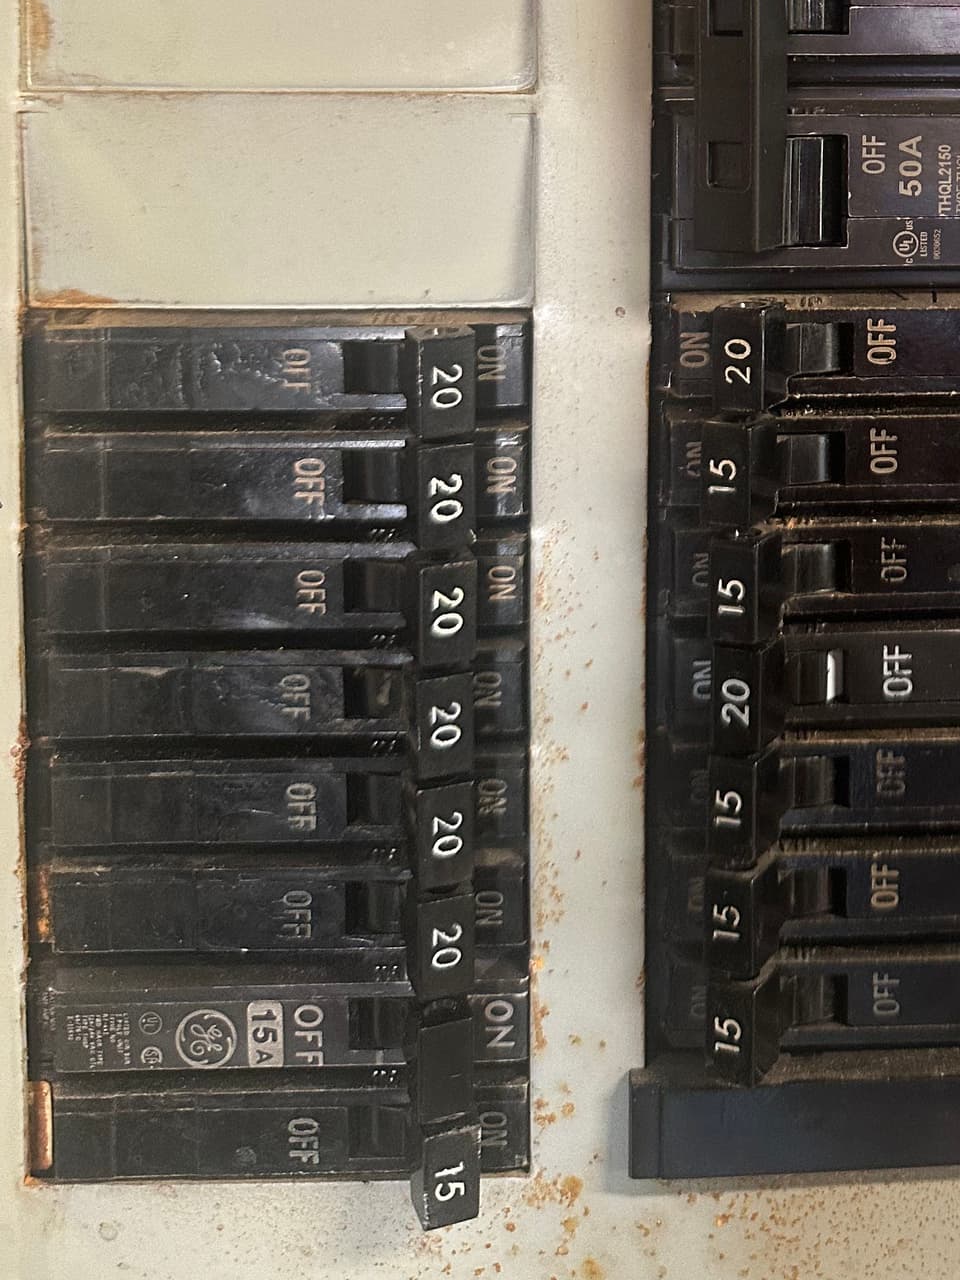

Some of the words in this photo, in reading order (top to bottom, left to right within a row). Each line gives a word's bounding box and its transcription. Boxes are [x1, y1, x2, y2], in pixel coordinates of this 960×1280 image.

[861, 134, 886, 175] OFF
[898, 135, 922, 196] 50A
[938, 144, 952, 213] THQL2150
[906, 220, 913, 230] US
[477, 346, 507, 383] ON
[680, 331, 712, 368] ON
[724, 338, 753, 385] 20
[867, 318, 898, 365] OFF
[282, 347, 311, 394] OFF
[431, 363, 463, 409] 20
[870, 427, 898, 475] OFF
[295, 457, 326, 506] OFF
[430, 473, 464, 523] 20
[486, 455, 518, 495] ON
[709, 457, 738, 496] 15
[881, 536, 908, 582] OFF
[296, 569, 326, 617] OFF
[488, 565, 515, 602] ON
[718, 578, 744, 616] 15
[431, 586, 464, 638] 20
[473, 671, 502, 710] ON
[882, 644, 913, 698] OFF
[281, 673, 310, 720] OFF
[721, 679, 751, 727] 20
[431, 700, 462, 750] 20
[875, 748, 906, 798] OFF
[286, 781, 316, 832] OFF
[478, 779, 508, 815] ON
[715, 789, 742, 827] 15
[431, 810, 464, 859] 20
[475, 889, 504, 927] ON
[871, 863, 899, 910] OFF
[282, 889, 311, 938] OFF
[712, 904, 741, 940] 15
[431, 923, 462, 969] 20
[872, 971, 900, 1015] OFF
[293, 1004, 323, 1066] OFF
[485, 1000, 514, 1049] ON
[713, 1017, 742, 1056] 15
[288, 1117, 320, 1166] OFF
[479, 1111, 508, 1148] ON
[433, 1160, 465, 1202] 15
